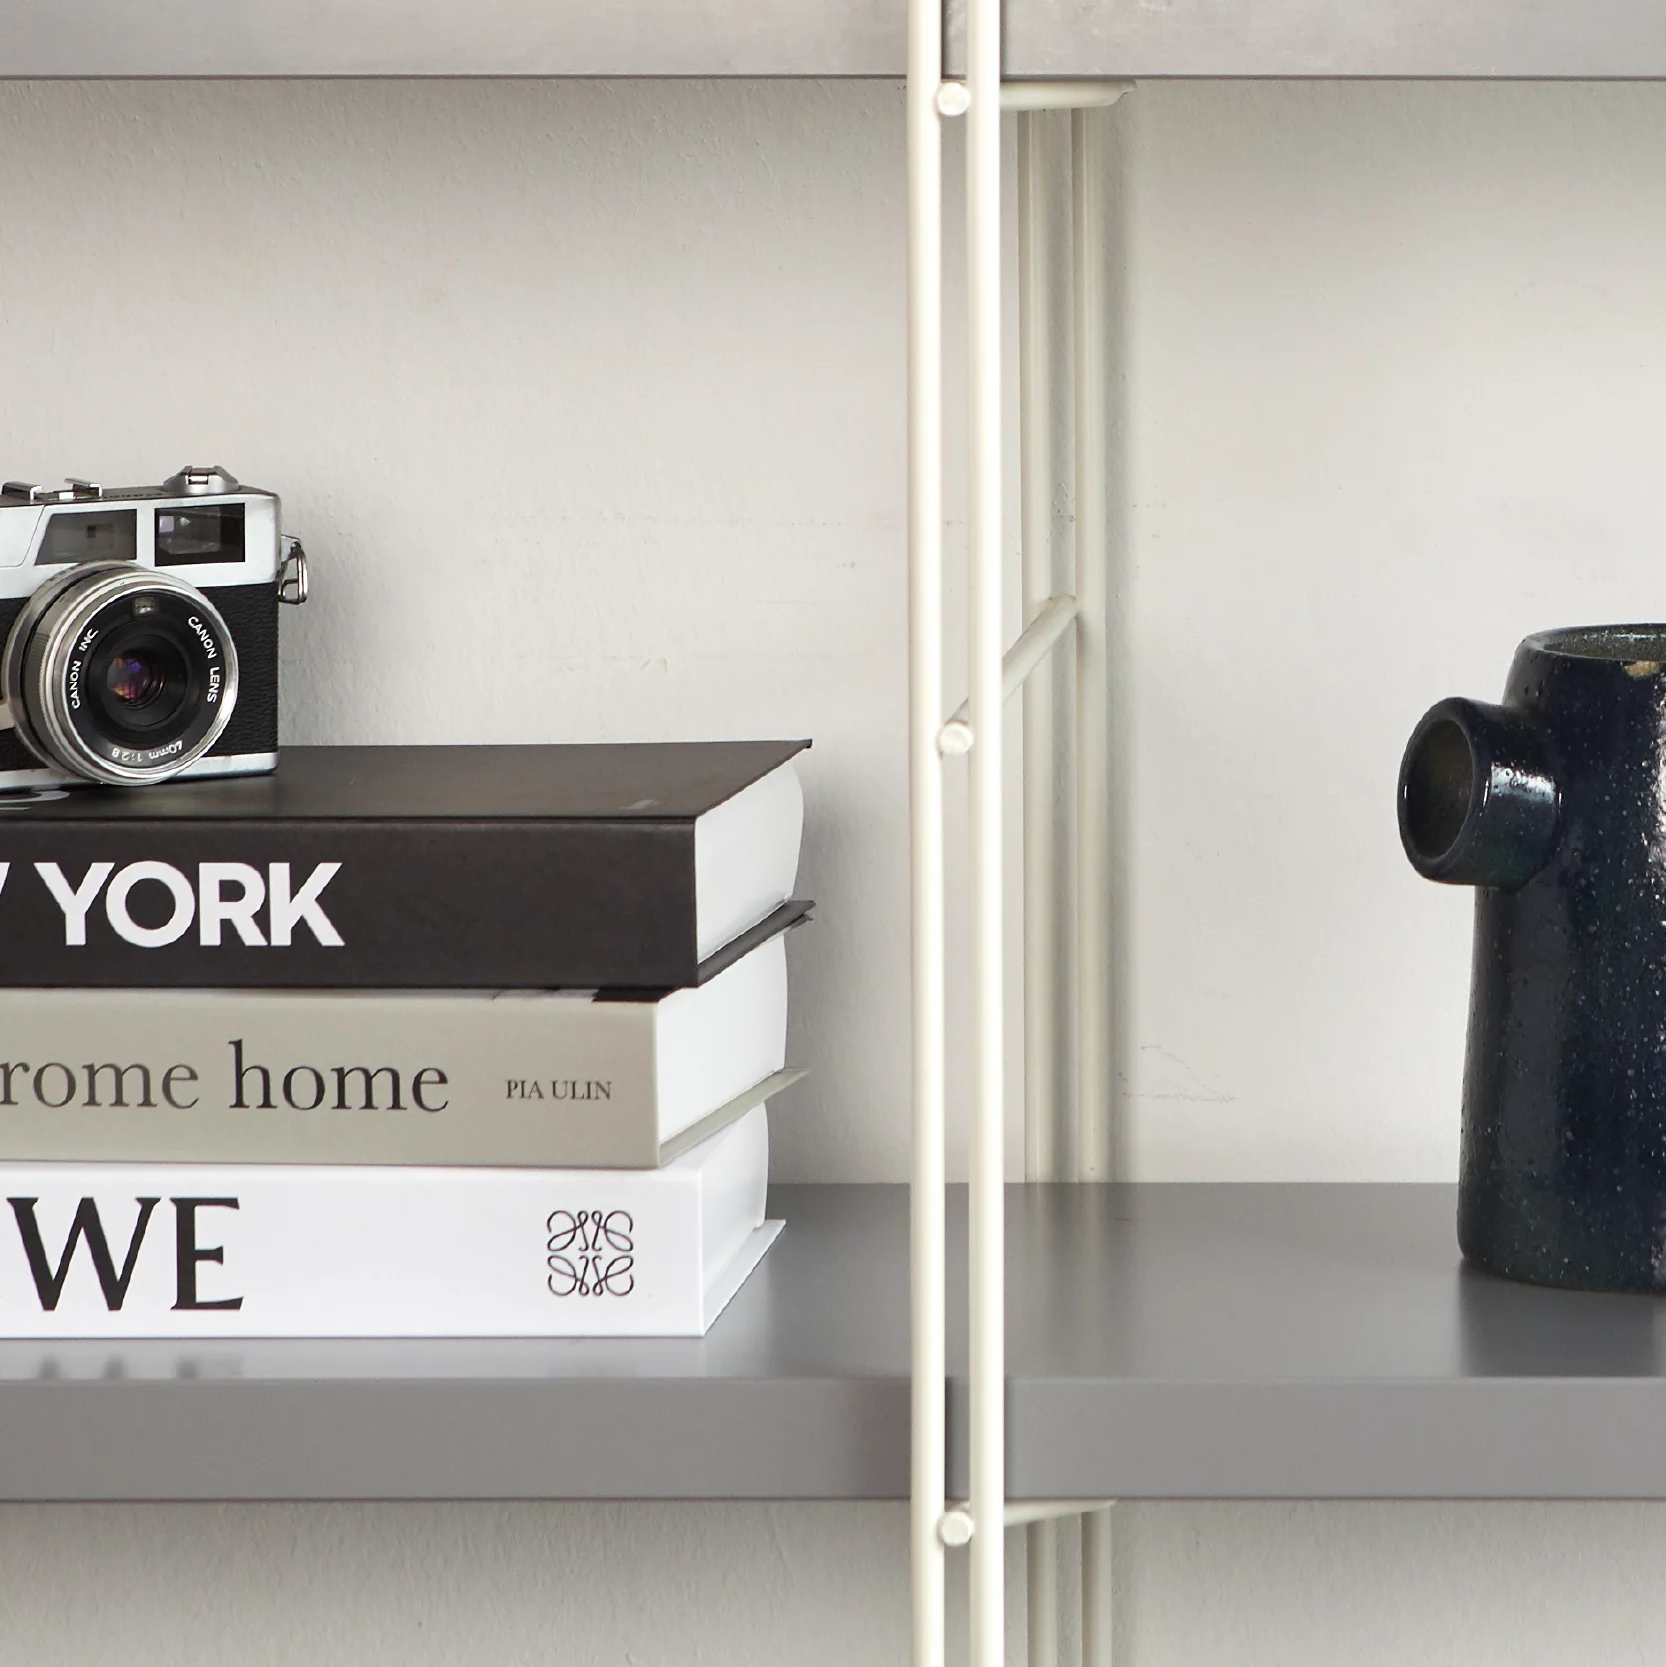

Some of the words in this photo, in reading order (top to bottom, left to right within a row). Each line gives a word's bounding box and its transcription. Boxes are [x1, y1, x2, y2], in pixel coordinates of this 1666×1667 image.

[69, 660, 82, 710] CANON
[188, 615, 217, 659] CANON
[207, 666, 220, 703] LENS
[111, 747, 143, 762] 1:2.8
[148, 740, 183, 760] 40mm
[34, 860, 345, 948] YORK
[0, 1059, 200, 1110] rome
[228, 1039, 450, 1113] home
[506, 1078, 545, 1101] PIA
[551, 1078, 613, 1101] ULIN
[7, 1195, 245, 1312] WE
